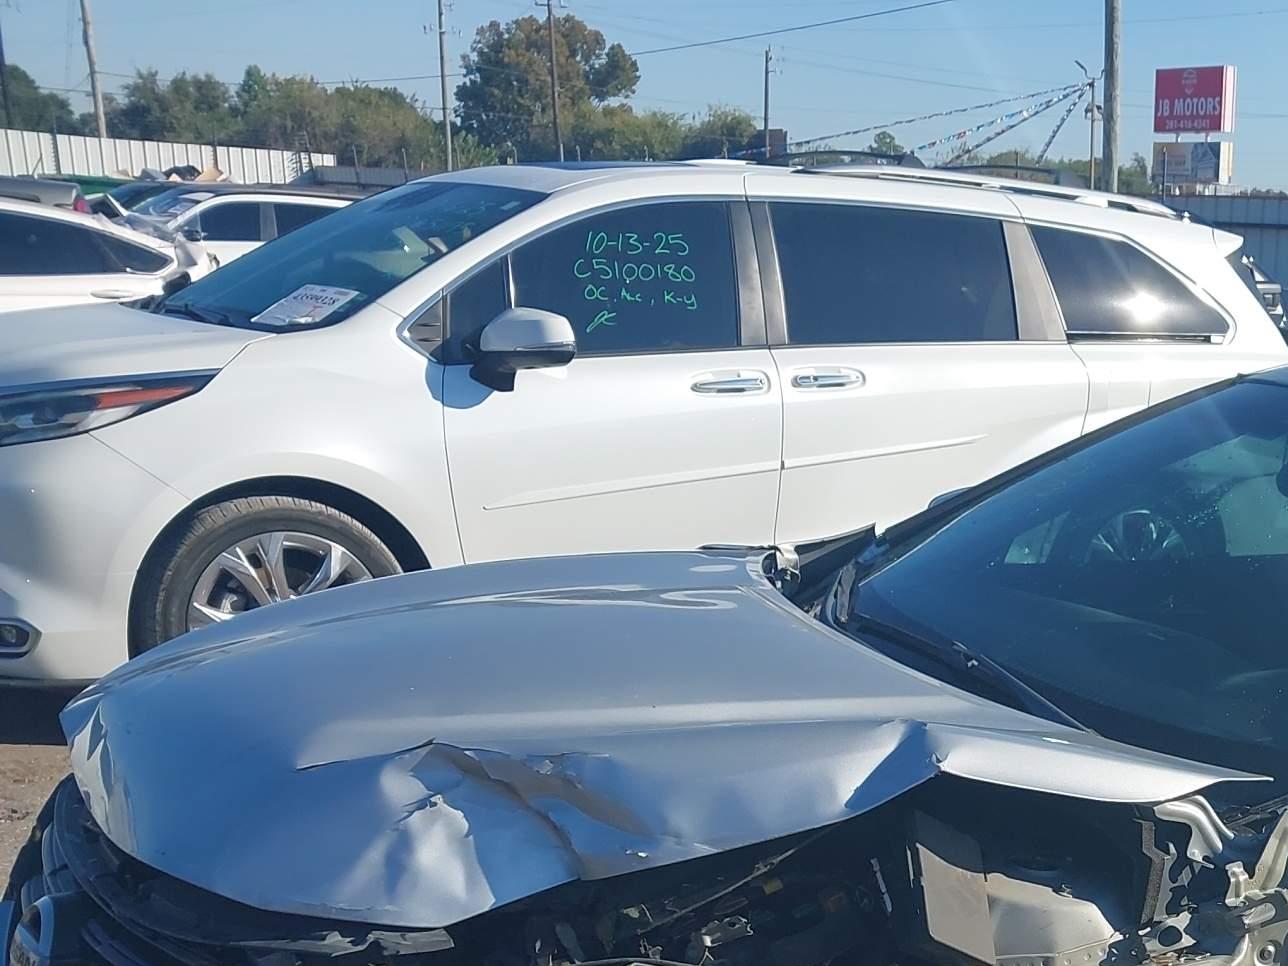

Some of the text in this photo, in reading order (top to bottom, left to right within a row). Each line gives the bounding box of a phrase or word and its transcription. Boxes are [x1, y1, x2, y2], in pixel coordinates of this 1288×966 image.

[1156, 96, 1221, 117] JB MOTORS
[585, 231, 690, 256] 10-13-25
